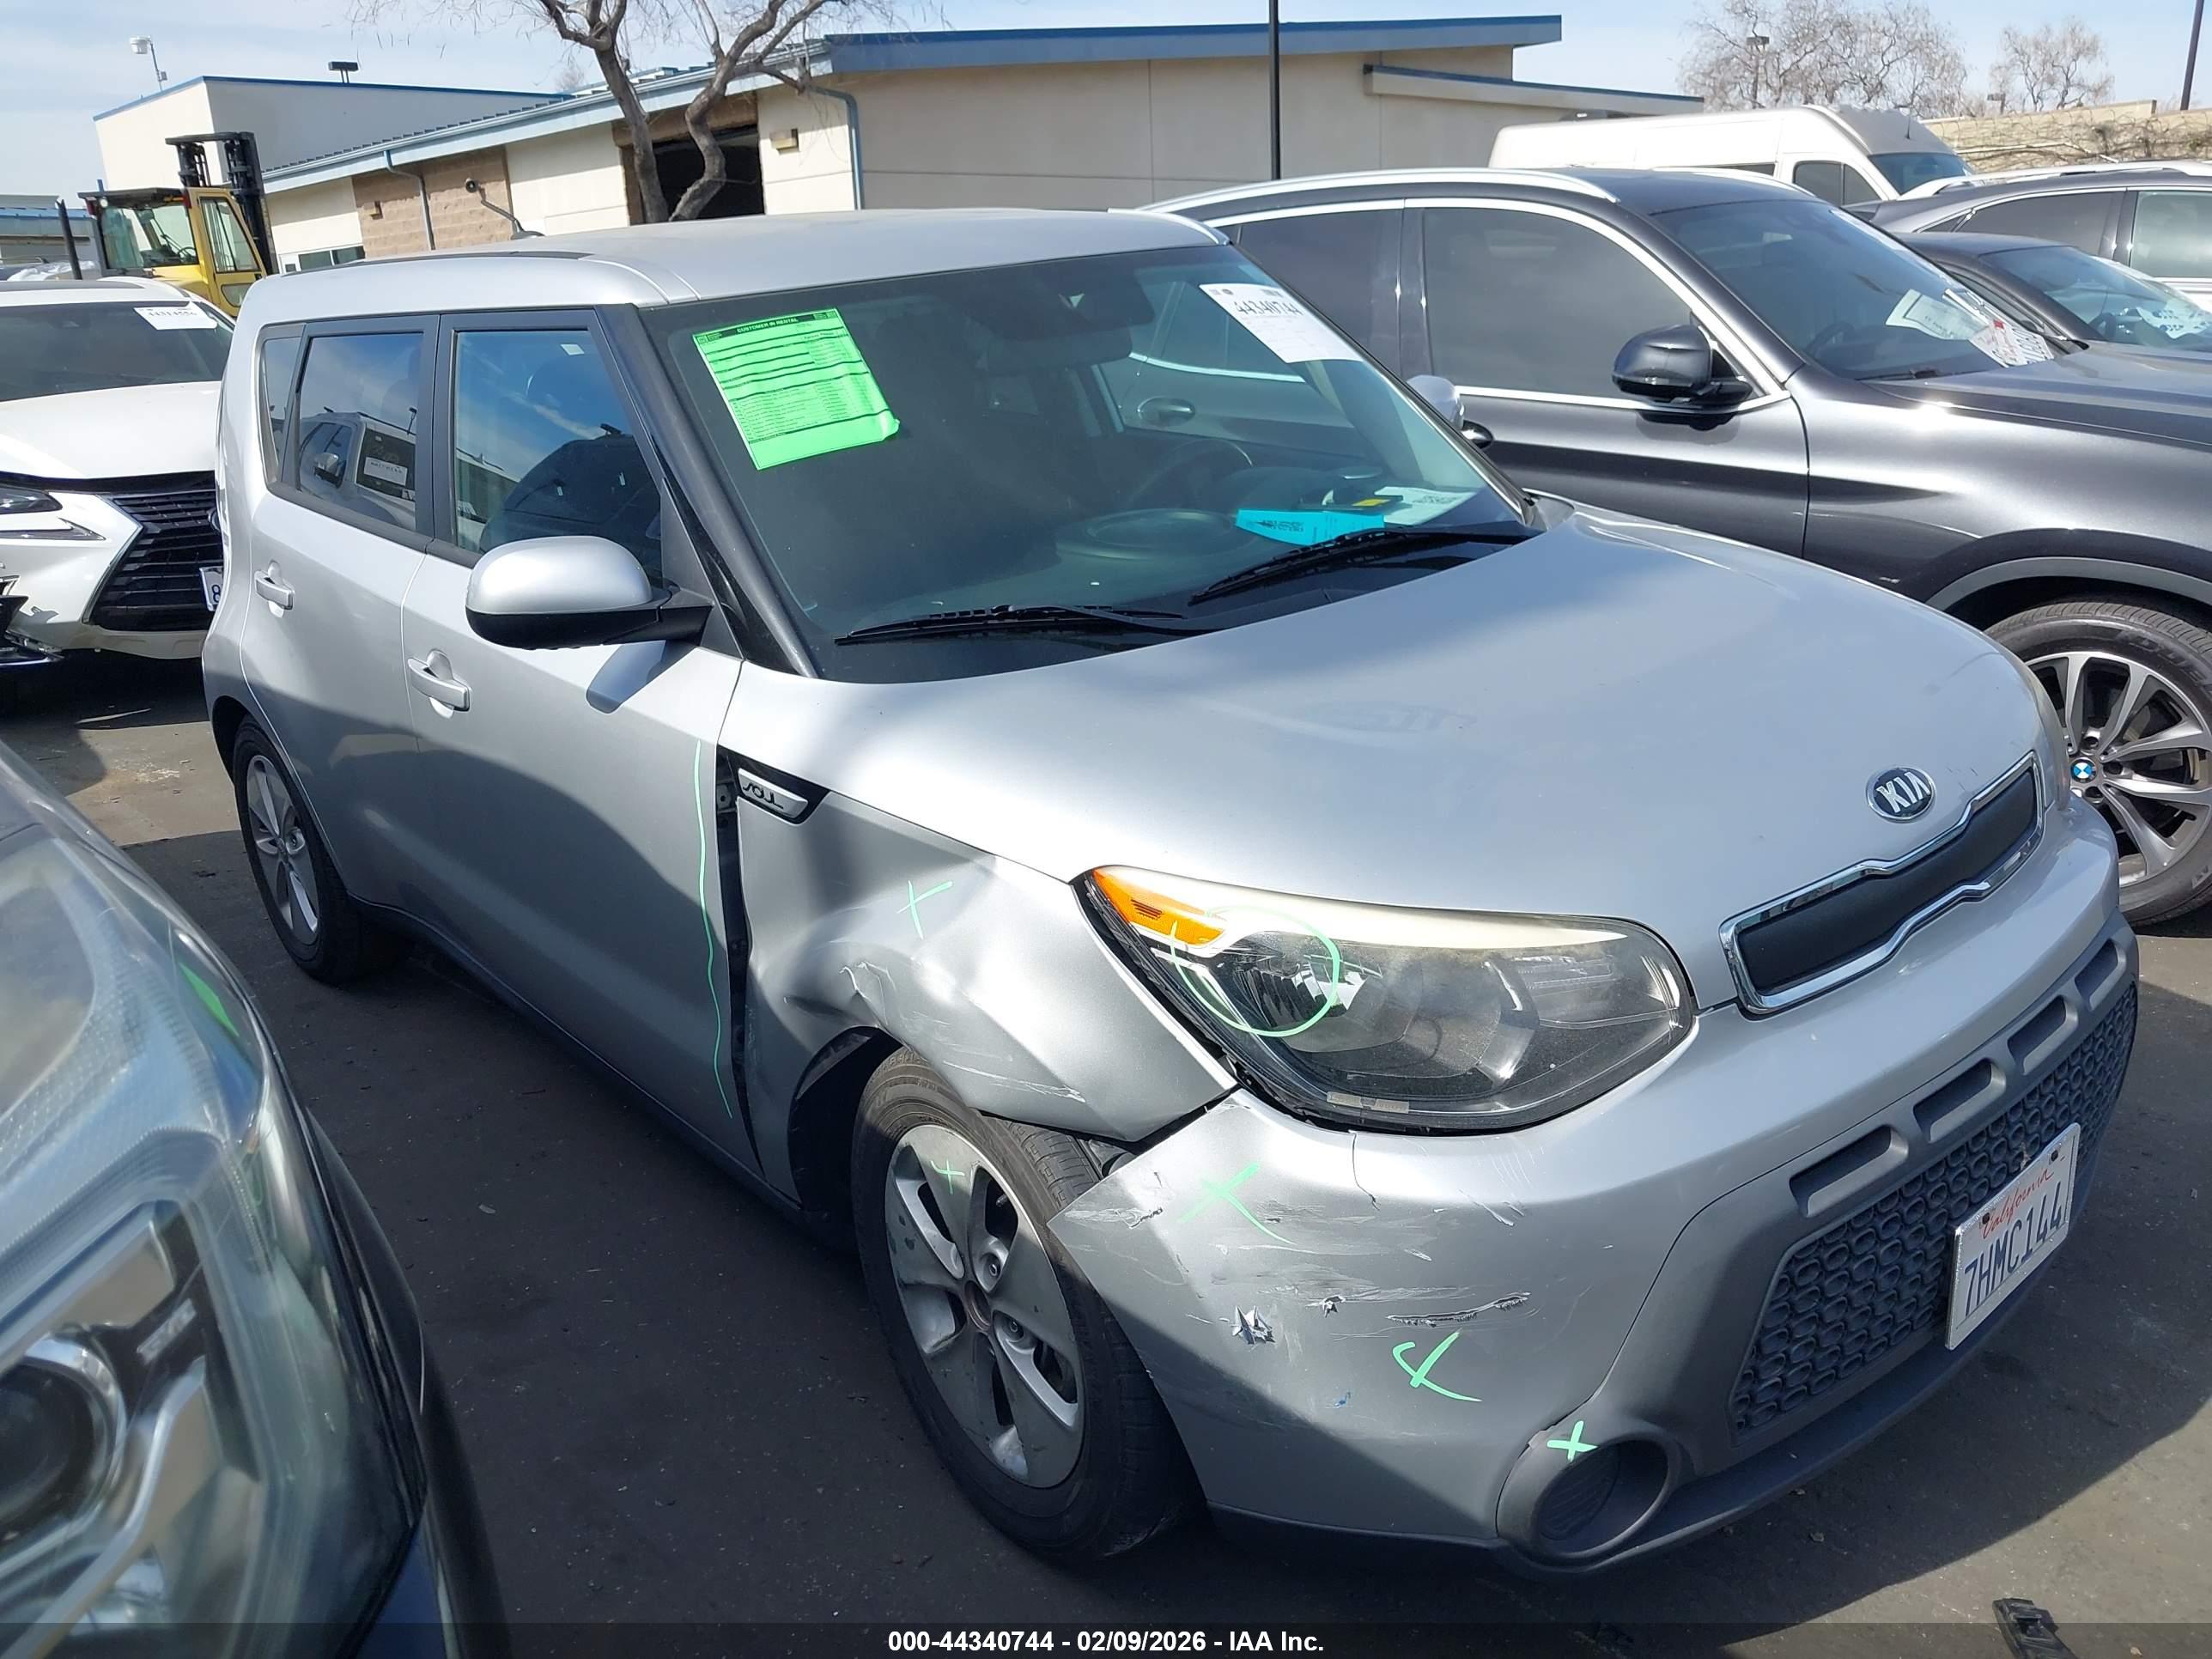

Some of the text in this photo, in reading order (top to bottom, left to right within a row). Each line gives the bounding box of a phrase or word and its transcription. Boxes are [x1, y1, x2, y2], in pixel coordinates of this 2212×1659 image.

[737, 322, 769, 333] CUSTOMER
[775, 317, 799, 325] RENTAL
[1234, 301, 1304, 316] 44340744
[1876, 772, 1930, 812] KIA
[1981, 1168, 2055, 1239] California
[1964, 1181, 2063, 1316] 7HMC144
